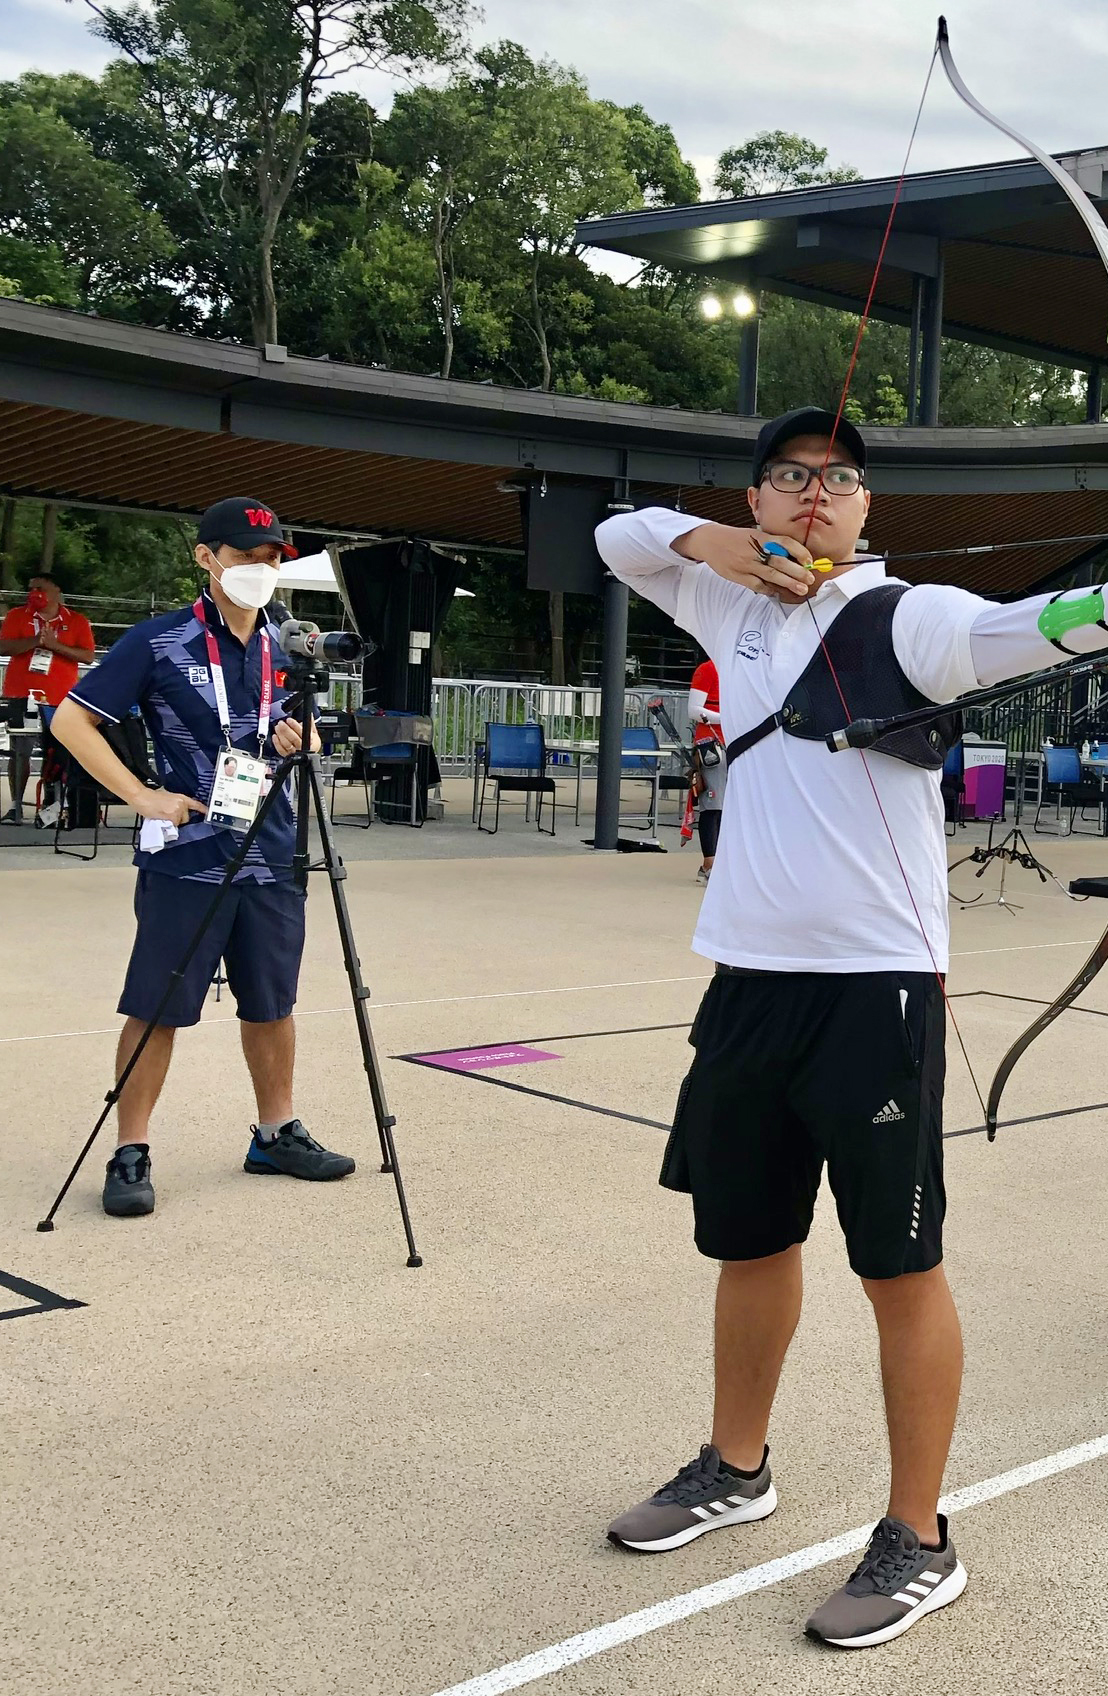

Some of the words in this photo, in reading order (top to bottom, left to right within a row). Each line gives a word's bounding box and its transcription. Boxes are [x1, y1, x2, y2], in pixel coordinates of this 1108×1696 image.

[972, 754, 991, 763] TOKYO
[991, 755, 1005, 764] 2020
[872, 1112, 906, 1124] adidas
